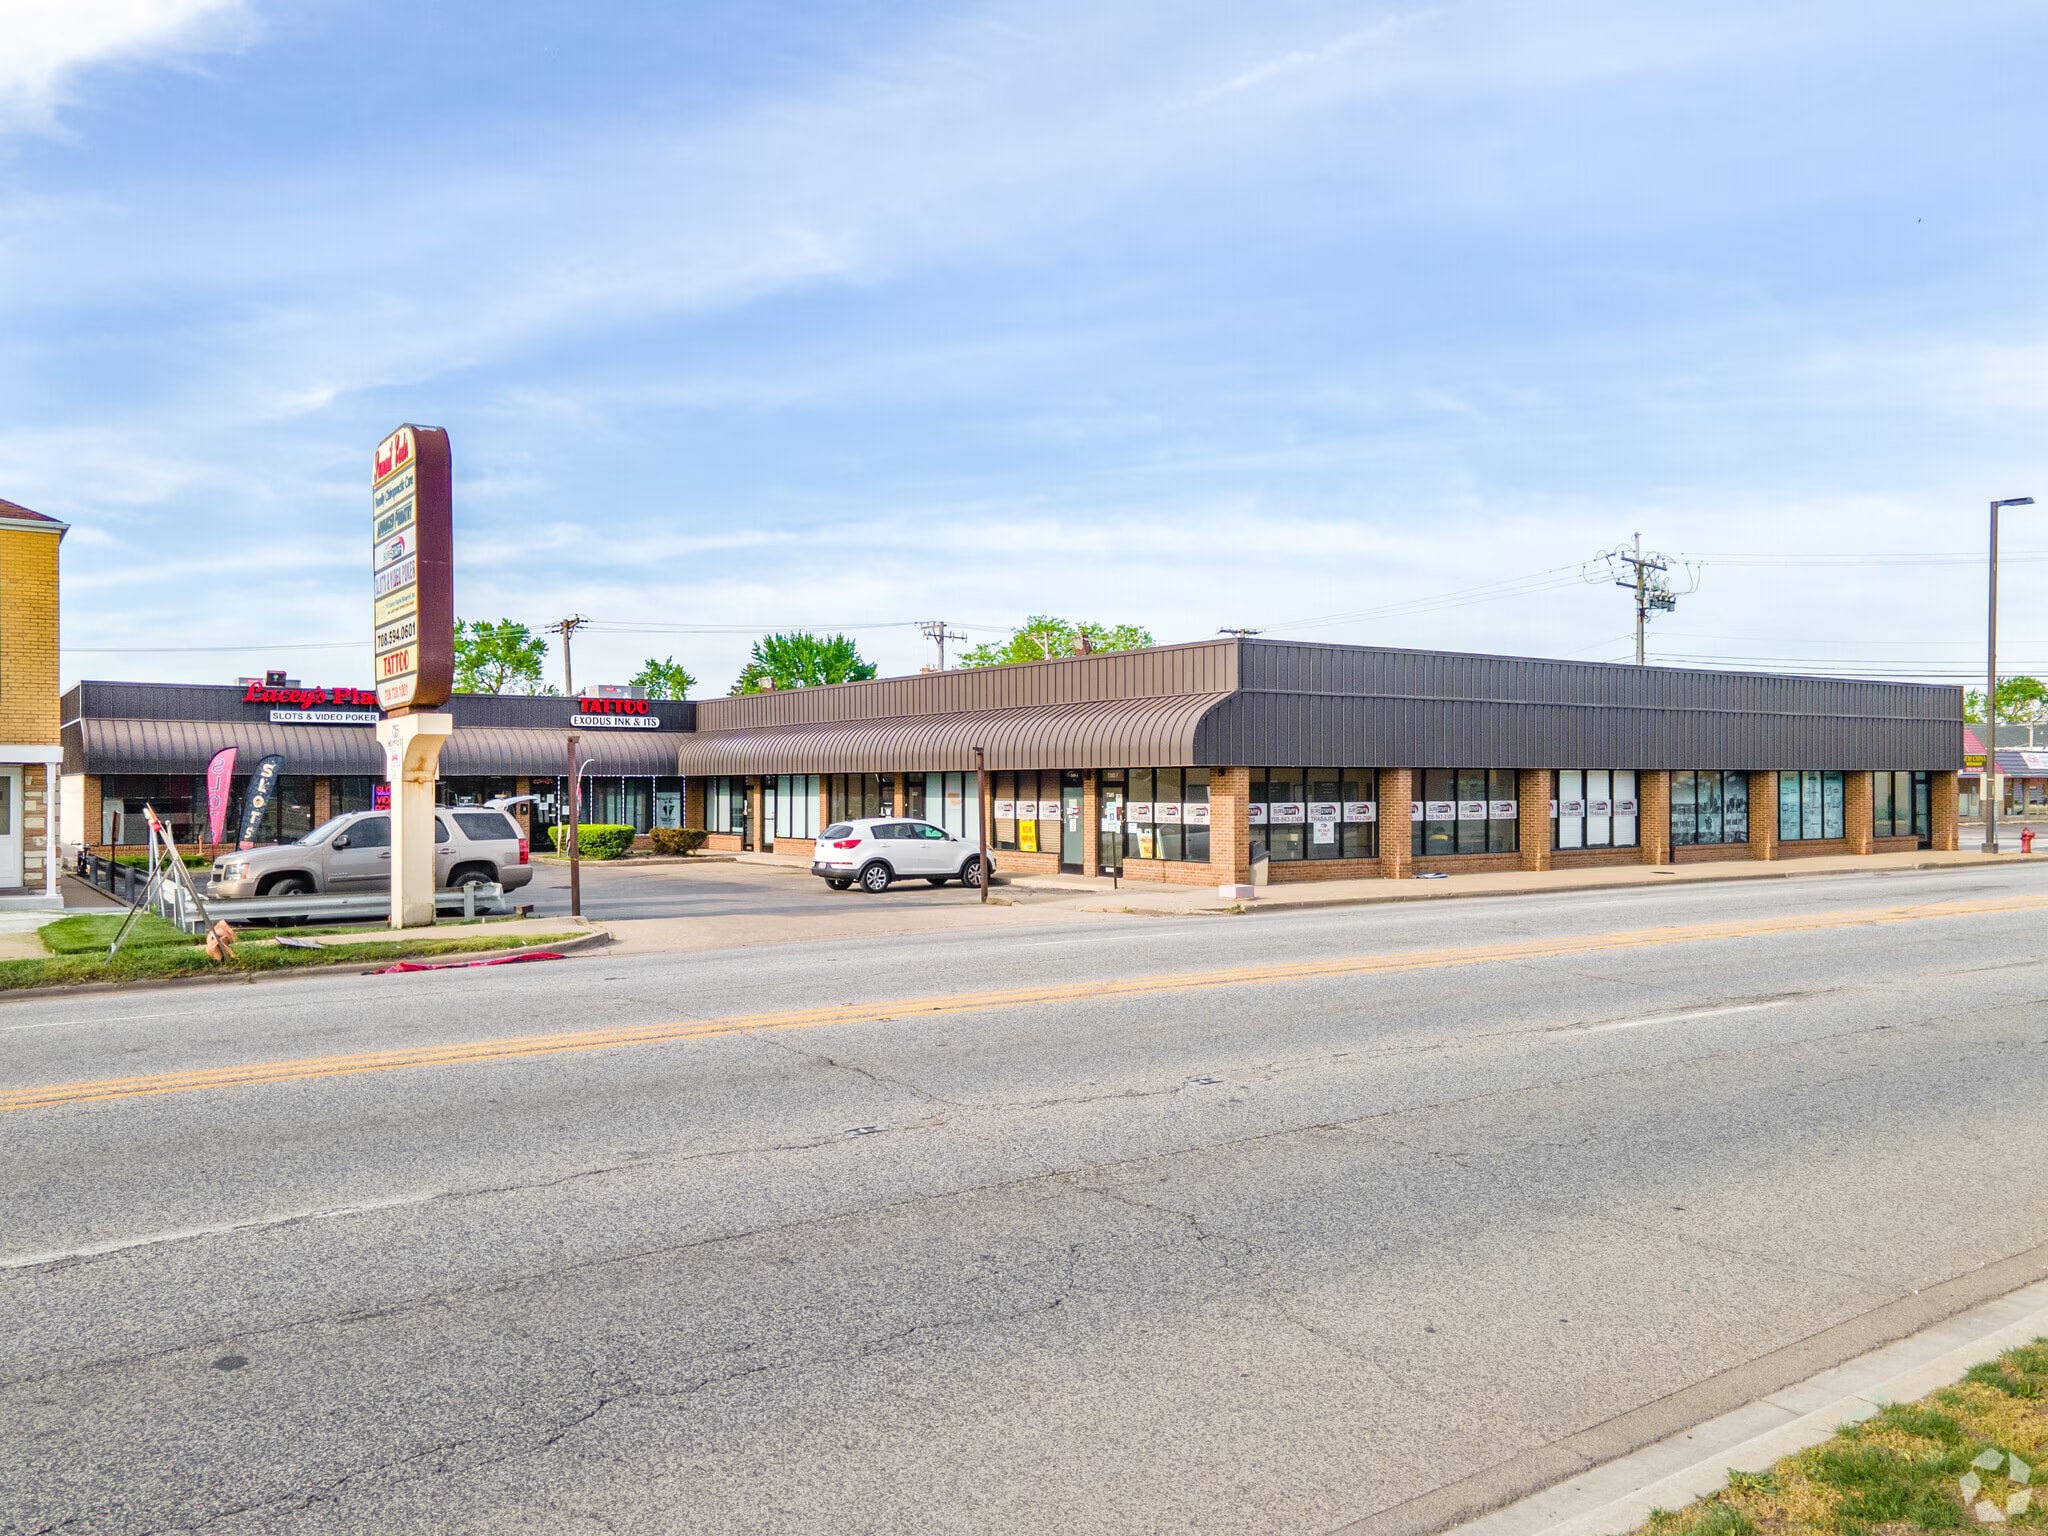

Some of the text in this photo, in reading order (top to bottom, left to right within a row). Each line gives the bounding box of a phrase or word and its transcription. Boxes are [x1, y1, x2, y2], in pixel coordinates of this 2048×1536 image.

[377, 622, 416, 648] 708.594.0601
[383, 649, 409, 676] TATTOO
[242, 679, 378, 710] Lacey's Pla
[578, 697, 649, 714] TATTOO
[272, 712, 303, 720] SLOTS
[315, 713, 343, 721] VIDEO
[574, 716, 657, 727] EXODUS INK & ITS
[244, 763, 276, 838] SLOTS
